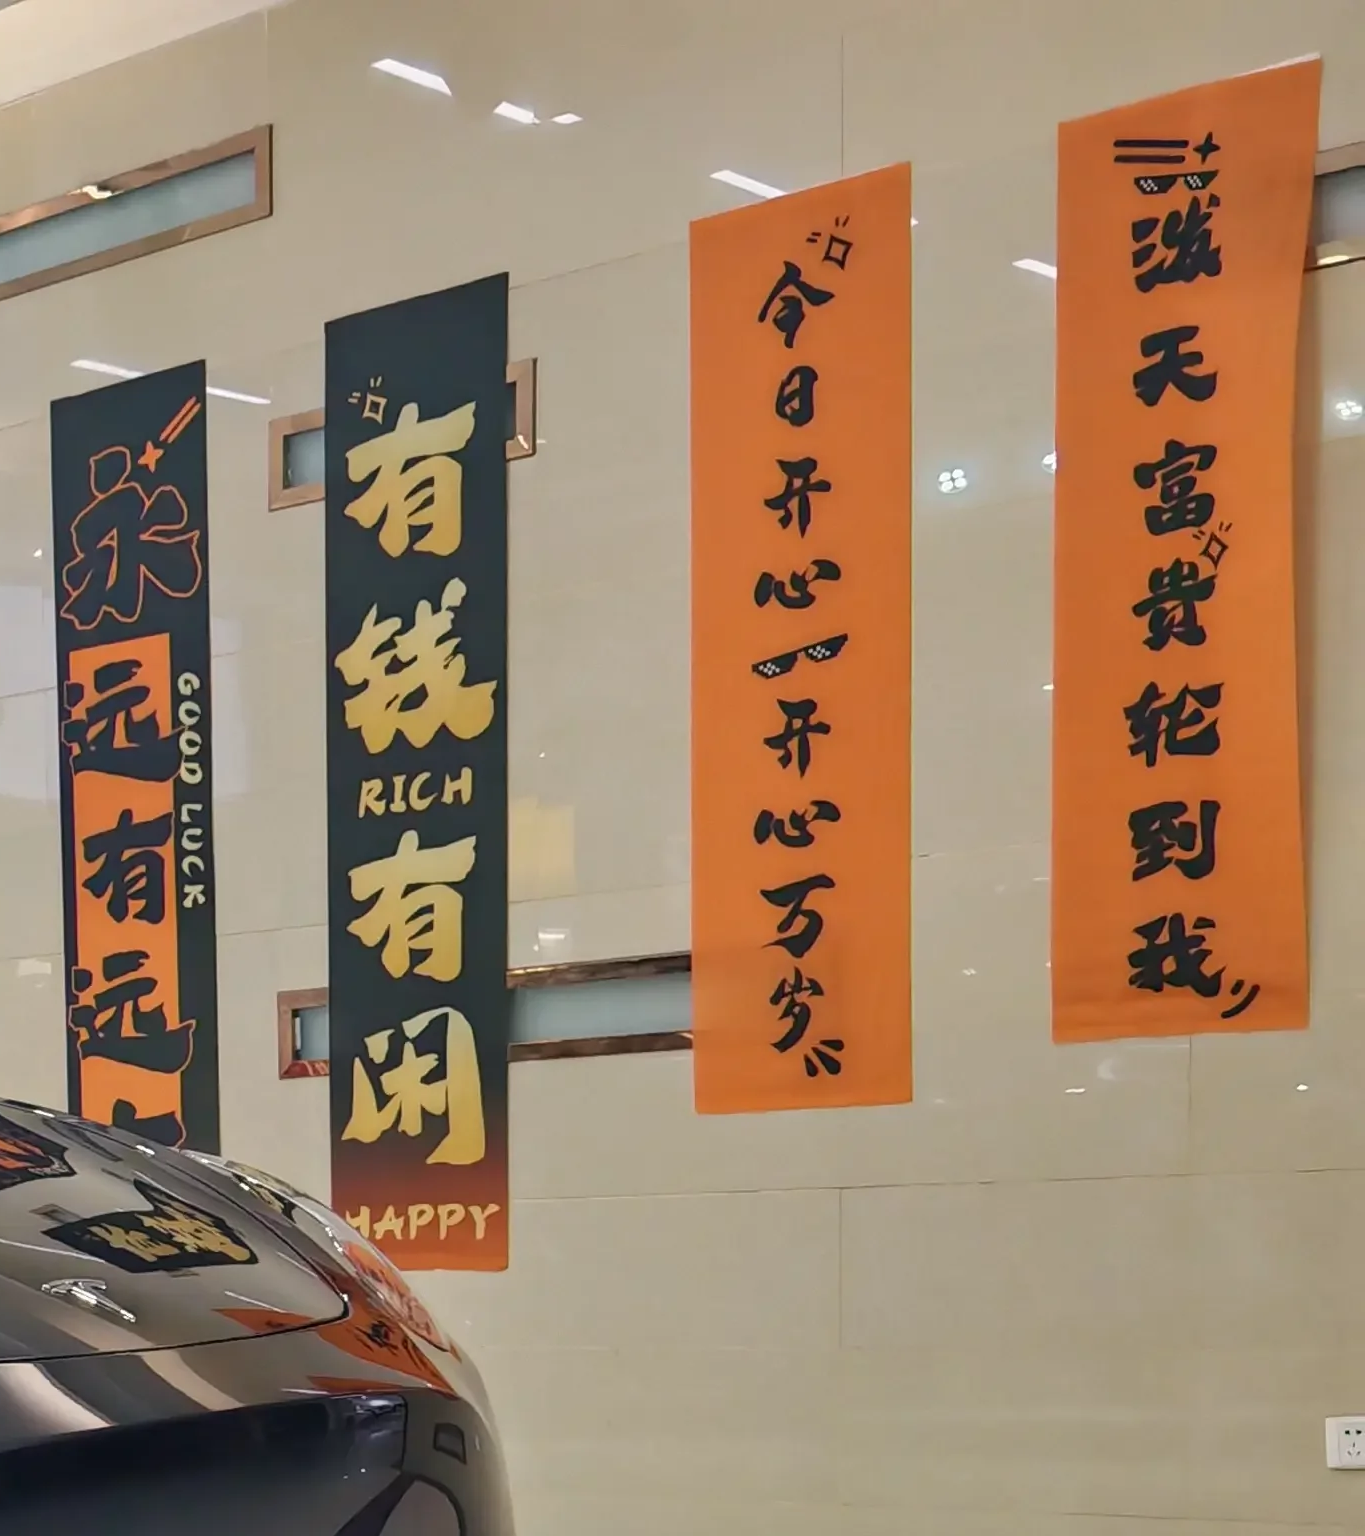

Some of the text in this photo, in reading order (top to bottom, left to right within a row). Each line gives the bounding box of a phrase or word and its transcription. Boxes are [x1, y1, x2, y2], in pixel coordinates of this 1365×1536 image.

[176, 671, 207, 908] GOOD LUCK
[357, 766, 474, 819] RICH
[340, 829, 486, 1165] 有闲
[344, 1203, 502, 1241] HAPPY
